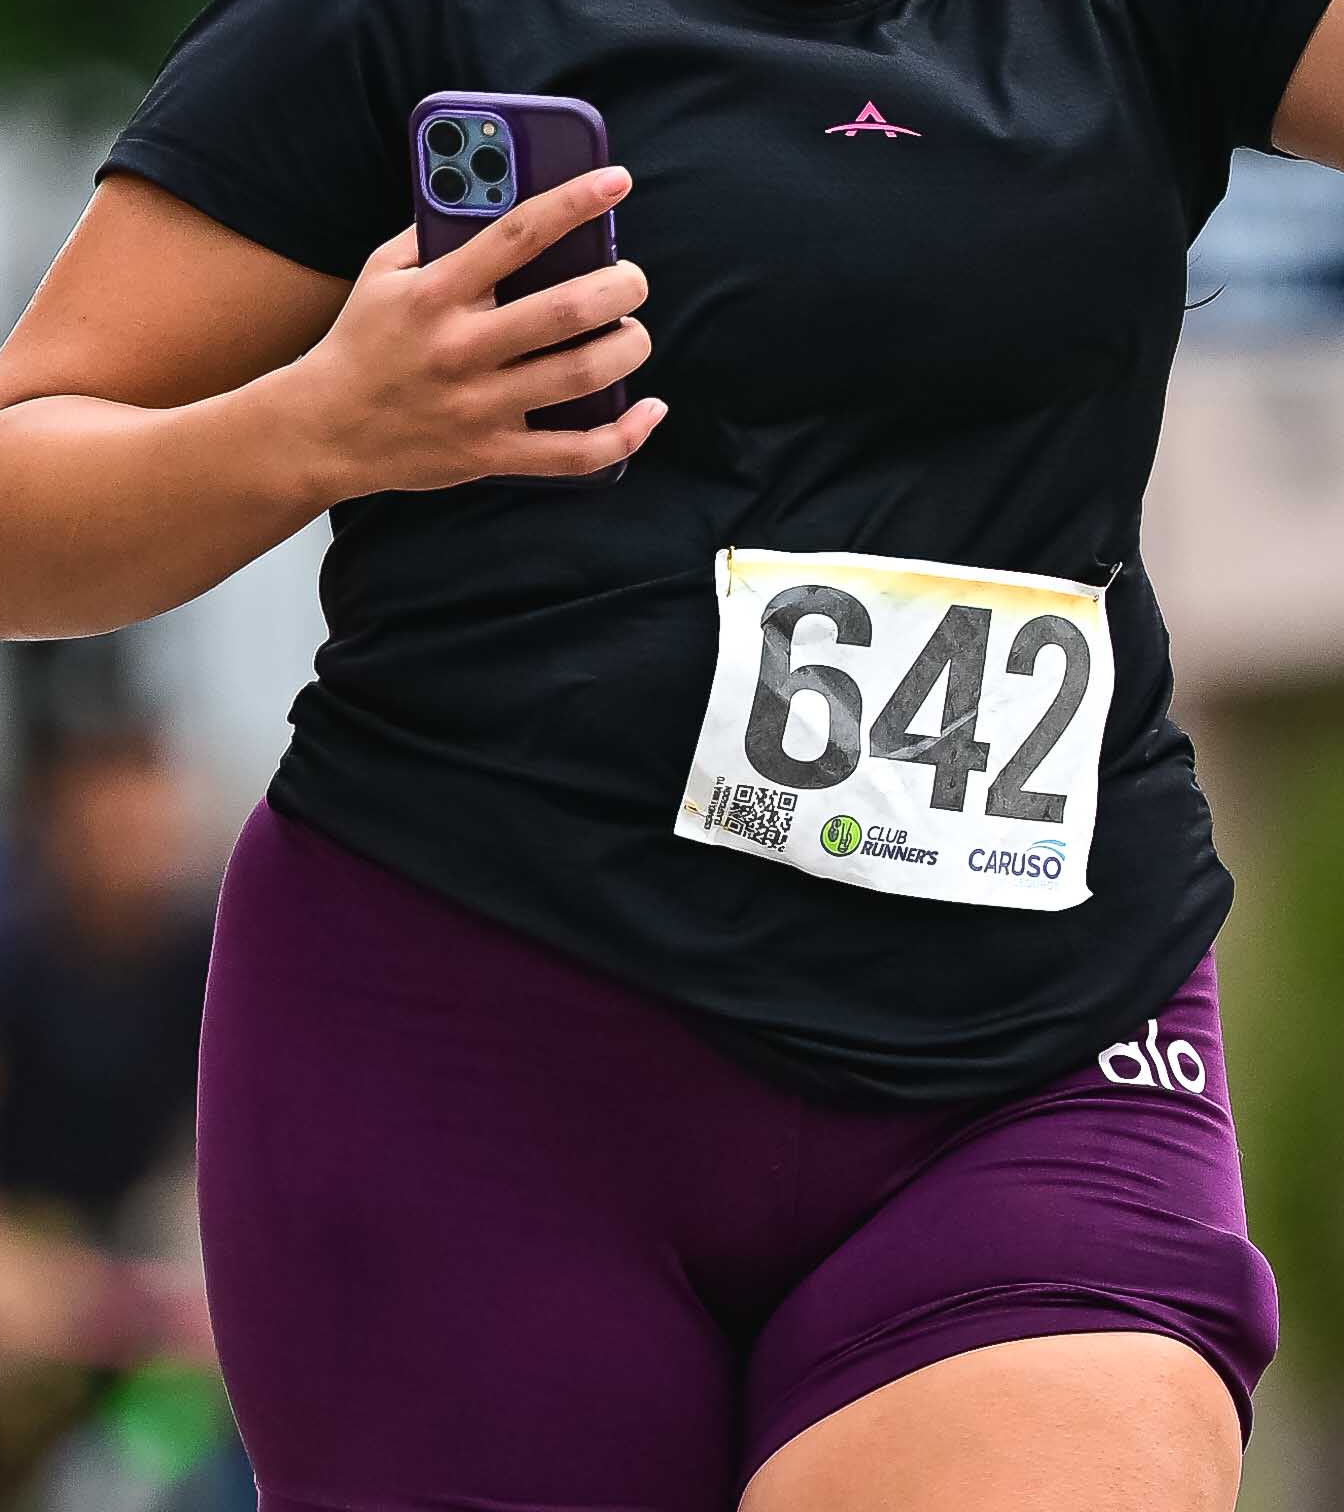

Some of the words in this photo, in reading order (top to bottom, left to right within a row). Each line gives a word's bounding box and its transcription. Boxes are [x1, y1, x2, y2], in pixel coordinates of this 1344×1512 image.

[745, 585, 1090, 823] 642
[866, 826, 907, 844] CLUB
[860, 840, 938, 865] RUNNER'S
[968, 849, 1061, 879] CARUSO
[1098, 1019, 1205, 1094] alo
